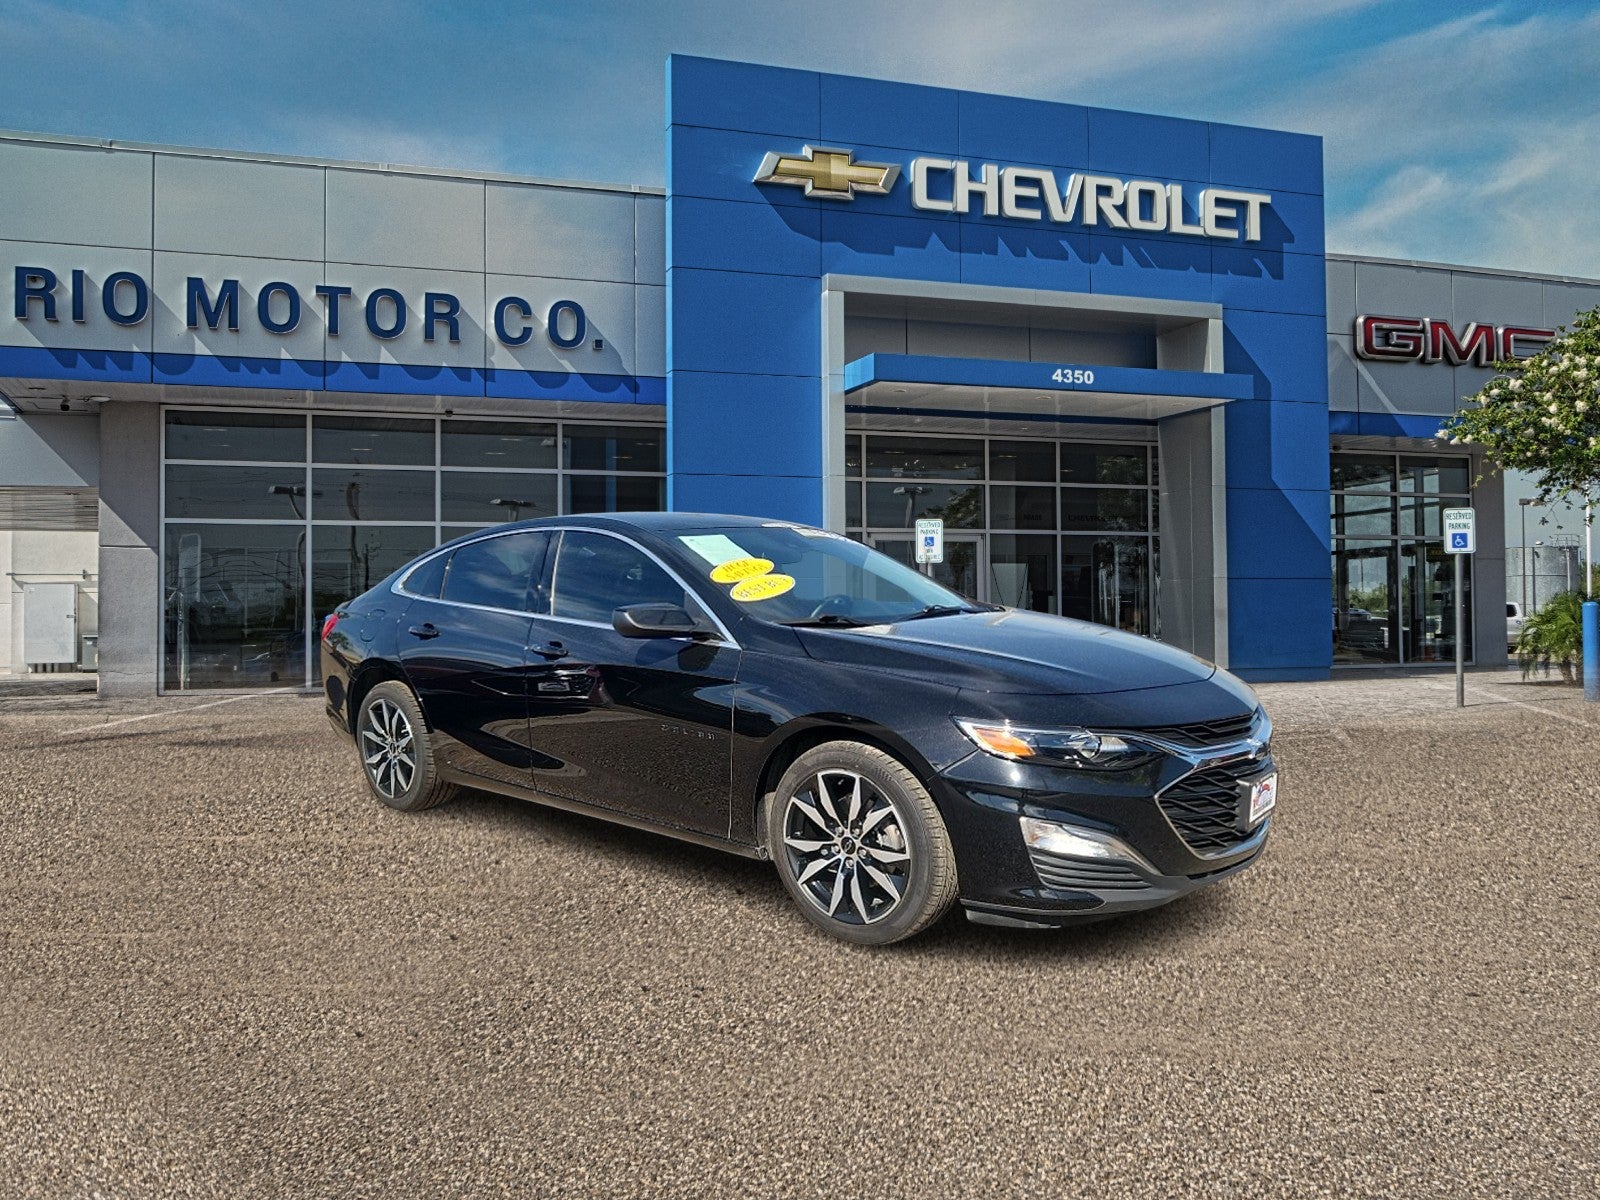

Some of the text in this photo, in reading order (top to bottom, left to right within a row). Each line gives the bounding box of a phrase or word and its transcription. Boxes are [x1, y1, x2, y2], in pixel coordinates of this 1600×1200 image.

[910, 157, 1272, 242] CHEVROLET
[14, 266, 604, 350] RIO MOTOR CO.
[1356, 314, 1558, 366] GMC
[1052, 368, 1094, 385] 4350
[1445, 512, 1472, 520] RESERVED
[1448, 522, 1471, 530] PARKING
